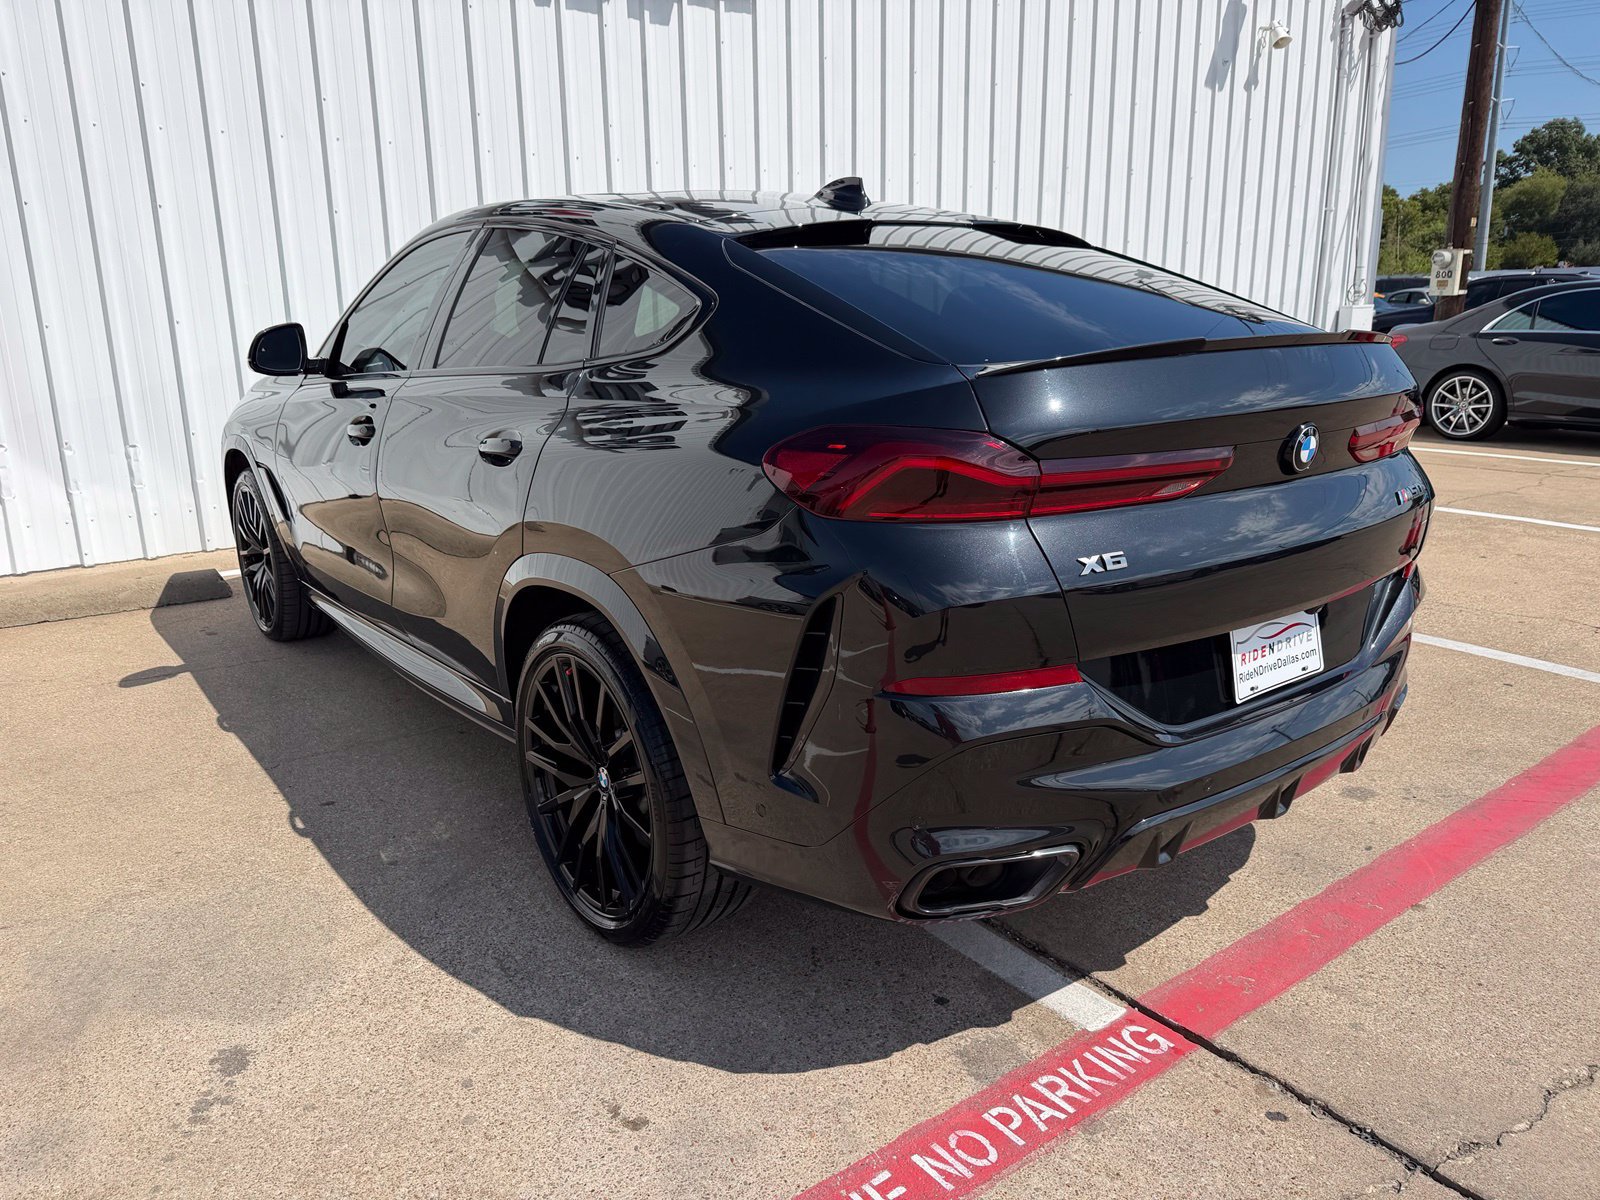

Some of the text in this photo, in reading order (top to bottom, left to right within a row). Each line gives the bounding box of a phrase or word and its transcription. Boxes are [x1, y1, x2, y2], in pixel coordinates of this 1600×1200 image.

[1435, 270, 1453, 279] 800
[1076, 551, 1128, 576] X6
[1239, 648, 1317, 684] RideNDriveDallas.com
[911, 1025, 1175, 1191] NO PARKING
